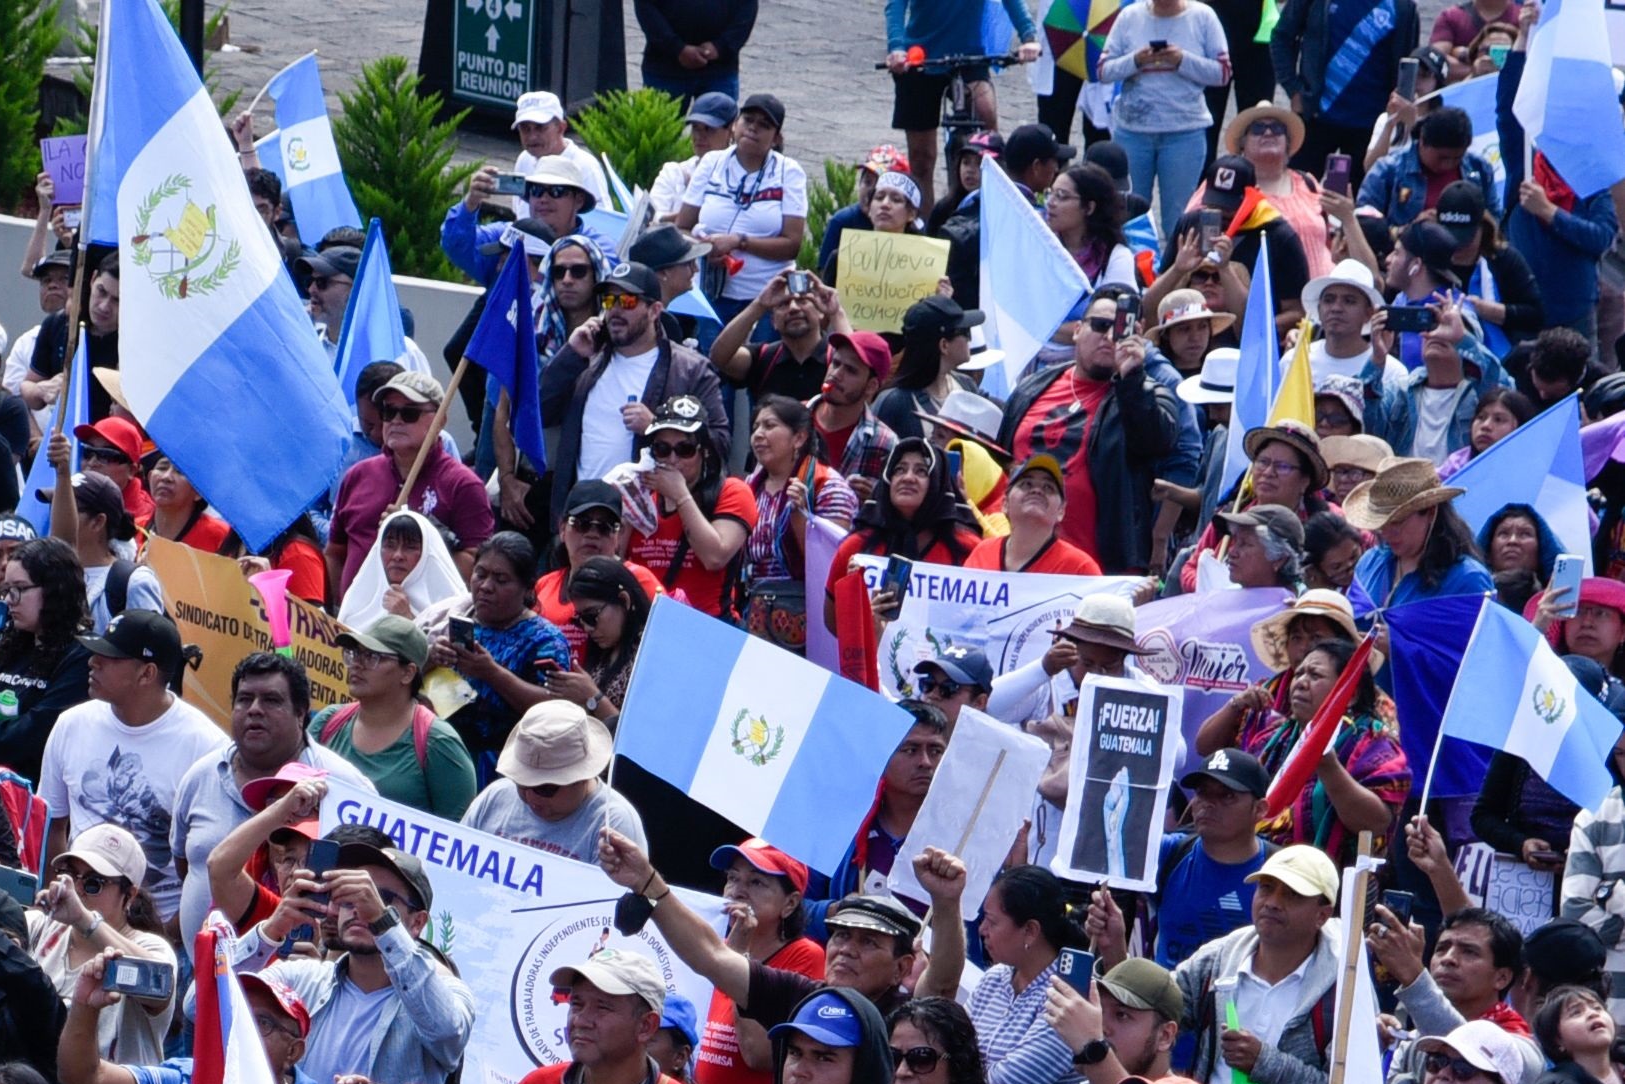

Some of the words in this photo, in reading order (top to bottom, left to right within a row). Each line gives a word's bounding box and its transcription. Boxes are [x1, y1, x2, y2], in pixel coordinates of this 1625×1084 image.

[457, 50, 504, 76] PUNTO
[508, 61, 526, 81] DE
[460, 71, 523, 99] REUNION
[874, 237, 935, 284] Nueva
[844, 279, 931, 300] revolució
[175, 600, 239, 637] SINDICATO
[1181, 640, 1246, 691] Mujer
[1098, 702, 1160, 734] ¡FUERZA!
[1099, 733, 1152, 756] GUATEMALA
[1208, 749, 1230, 771] LA
[541, 915, 601, 960] INDEPENDIENTES
[602, 916, 613, 927] DE
